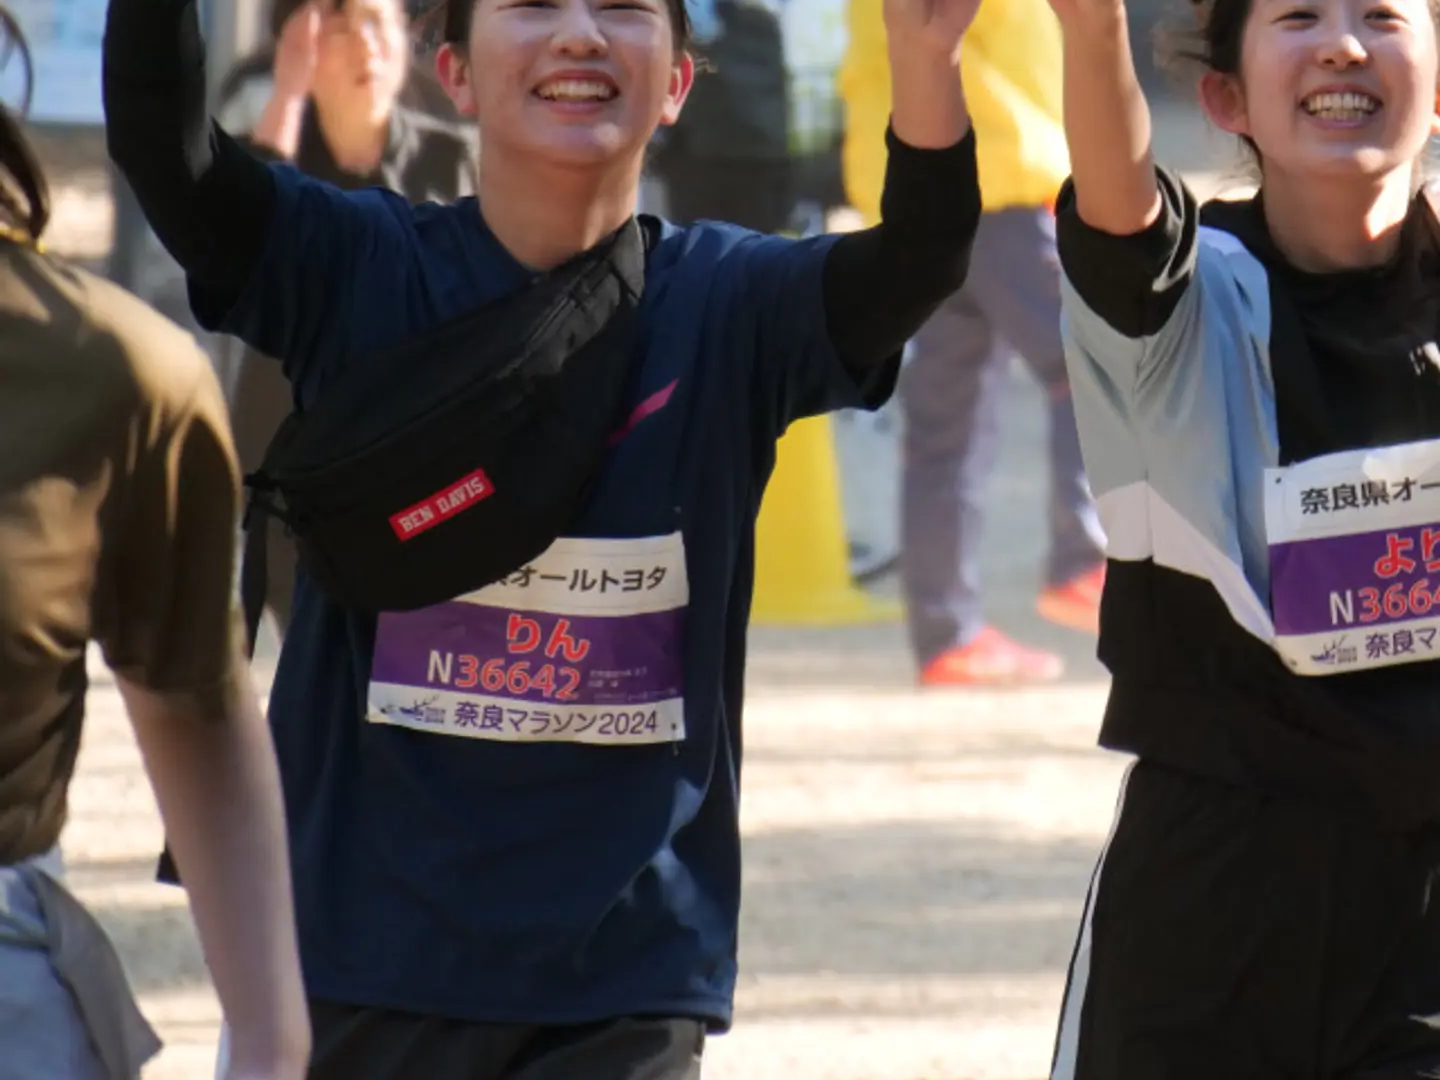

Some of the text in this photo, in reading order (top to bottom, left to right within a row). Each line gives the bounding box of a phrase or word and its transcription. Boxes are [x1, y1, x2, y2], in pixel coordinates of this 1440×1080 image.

[397, 475, 487, 533] BEN DAVIS
[500, 565, 668, 595] オールトヨタ
[506, 613, 591, 663] りん
[427, 649, 582, 700] N36642
[454, 701, 658, 736] 奈良マラソン2024
